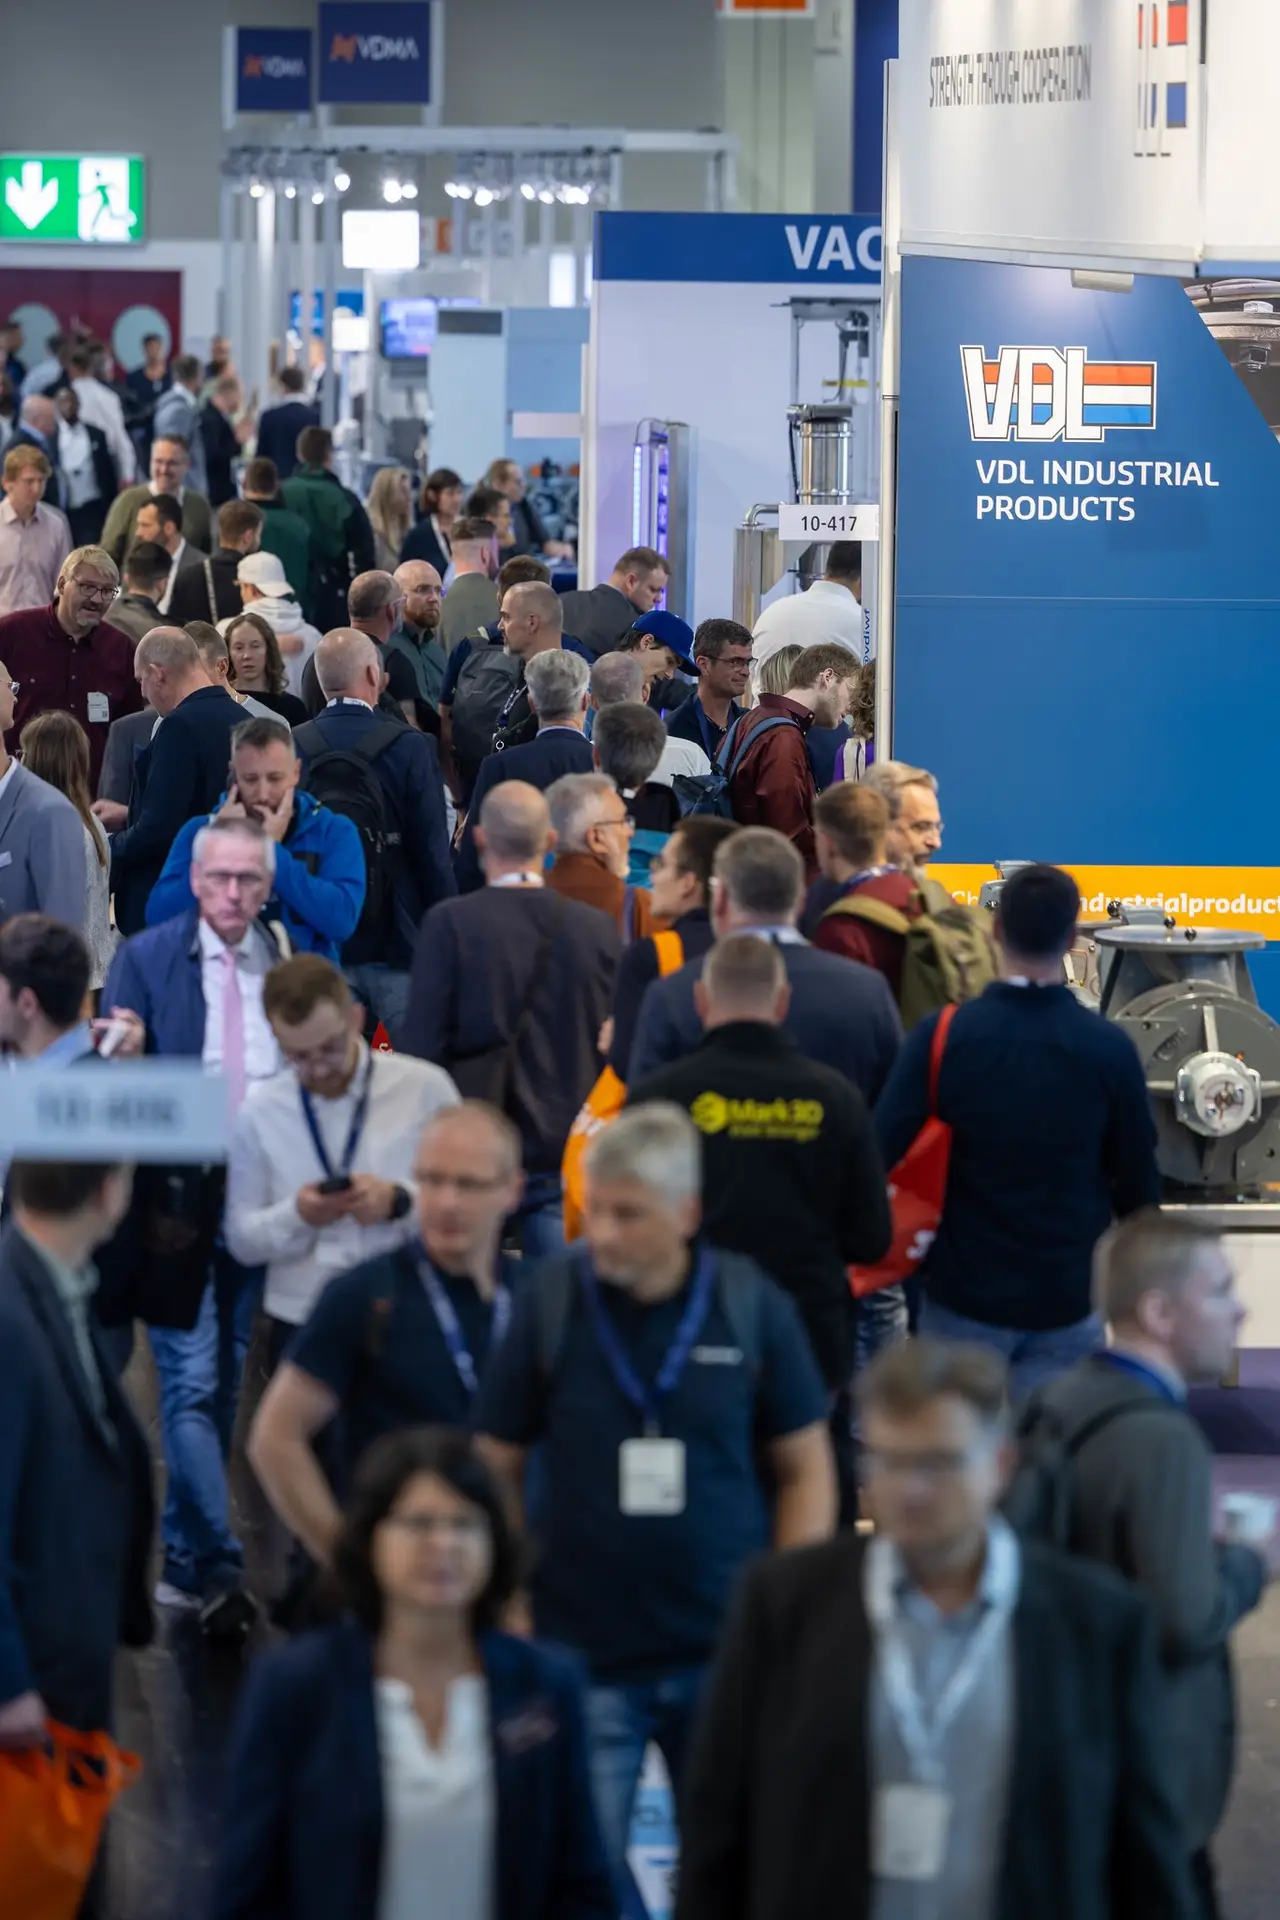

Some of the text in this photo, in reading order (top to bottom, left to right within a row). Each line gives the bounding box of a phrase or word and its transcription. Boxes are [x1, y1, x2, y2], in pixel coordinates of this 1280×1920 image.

[356, 35, 420, 61] VDMA
[929, 44, 1092, 108] STRENGTH THROUGH COOPERATION
[960, 345, 1104, 442] VDL
[975, 459, 1220, 487] VDL INDUSTRIAL
[976, 495, 1136, 522] PRODUCTS
[801, 515, 858, 532] 10-417
